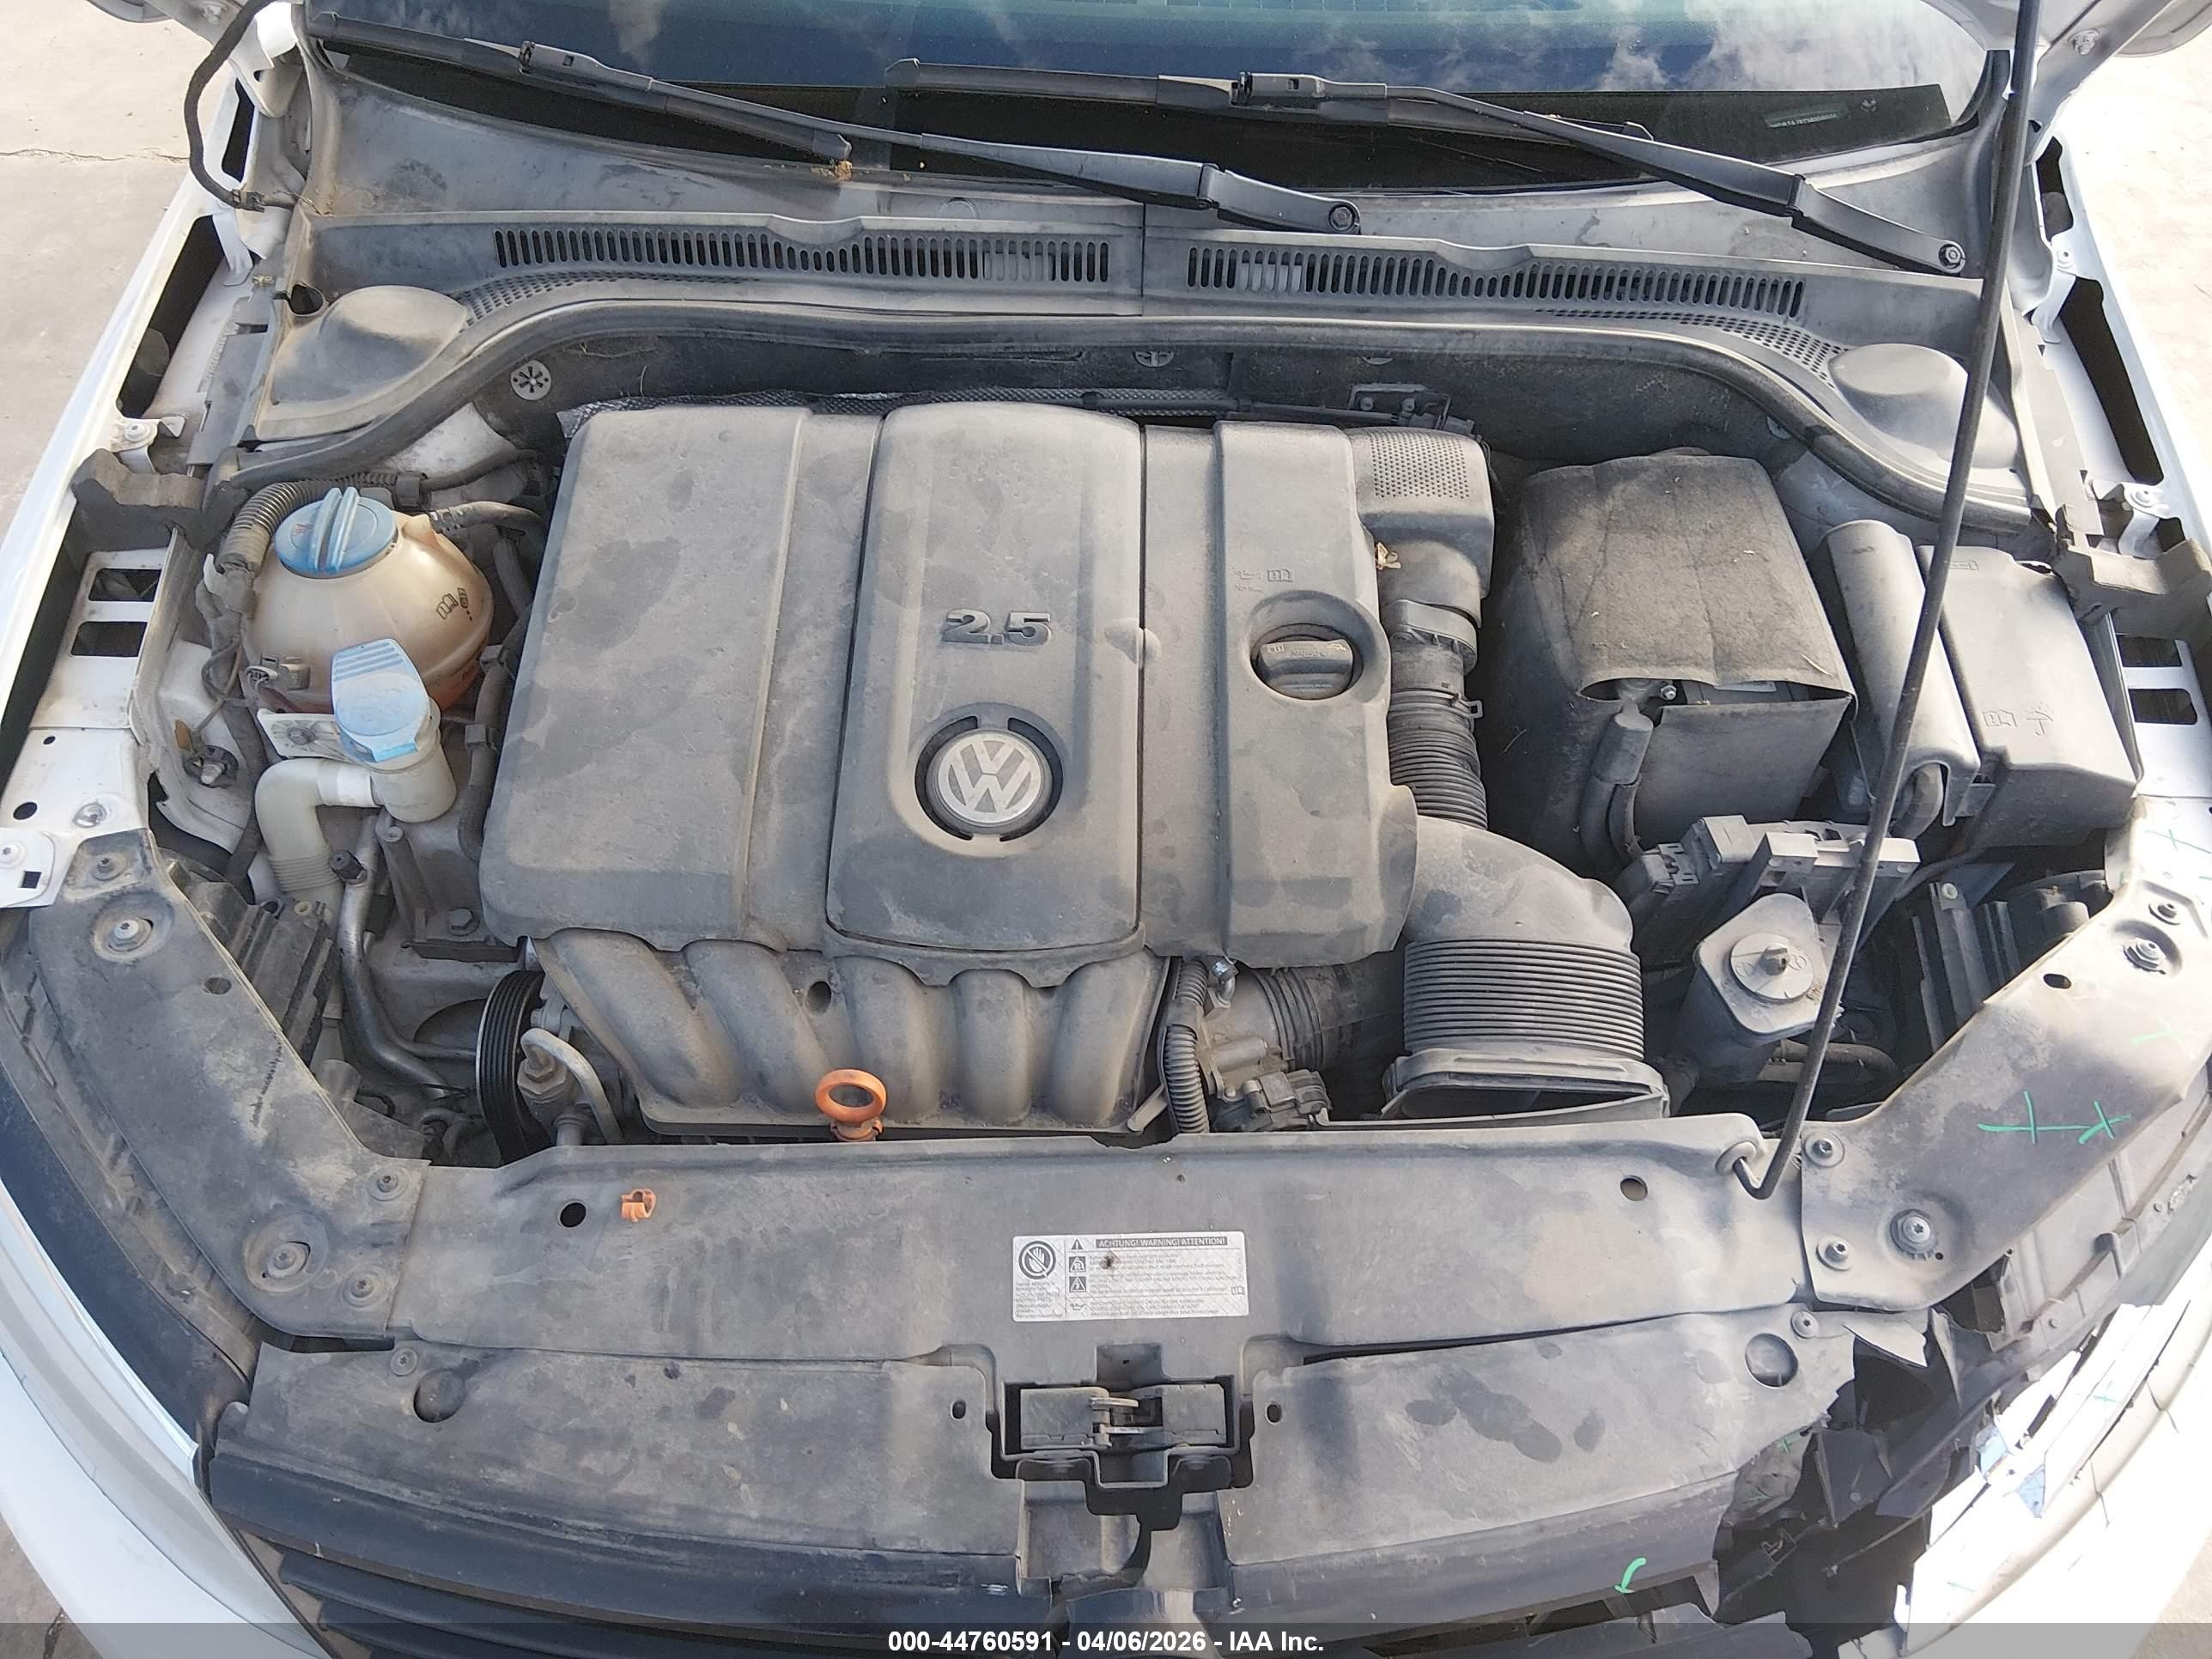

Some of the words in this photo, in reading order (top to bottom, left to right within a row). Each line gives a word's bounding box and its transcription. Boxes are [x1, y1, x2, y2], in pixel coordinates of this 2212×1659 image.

[942, 609, 1051, 645] 2.5
[1098, 1238, 1139, 1248] ACHTUNG!
[1139, 1237, 1180, 1247] WARNING!
[1181, 1237, 1225, 1246] ATTENTION!
